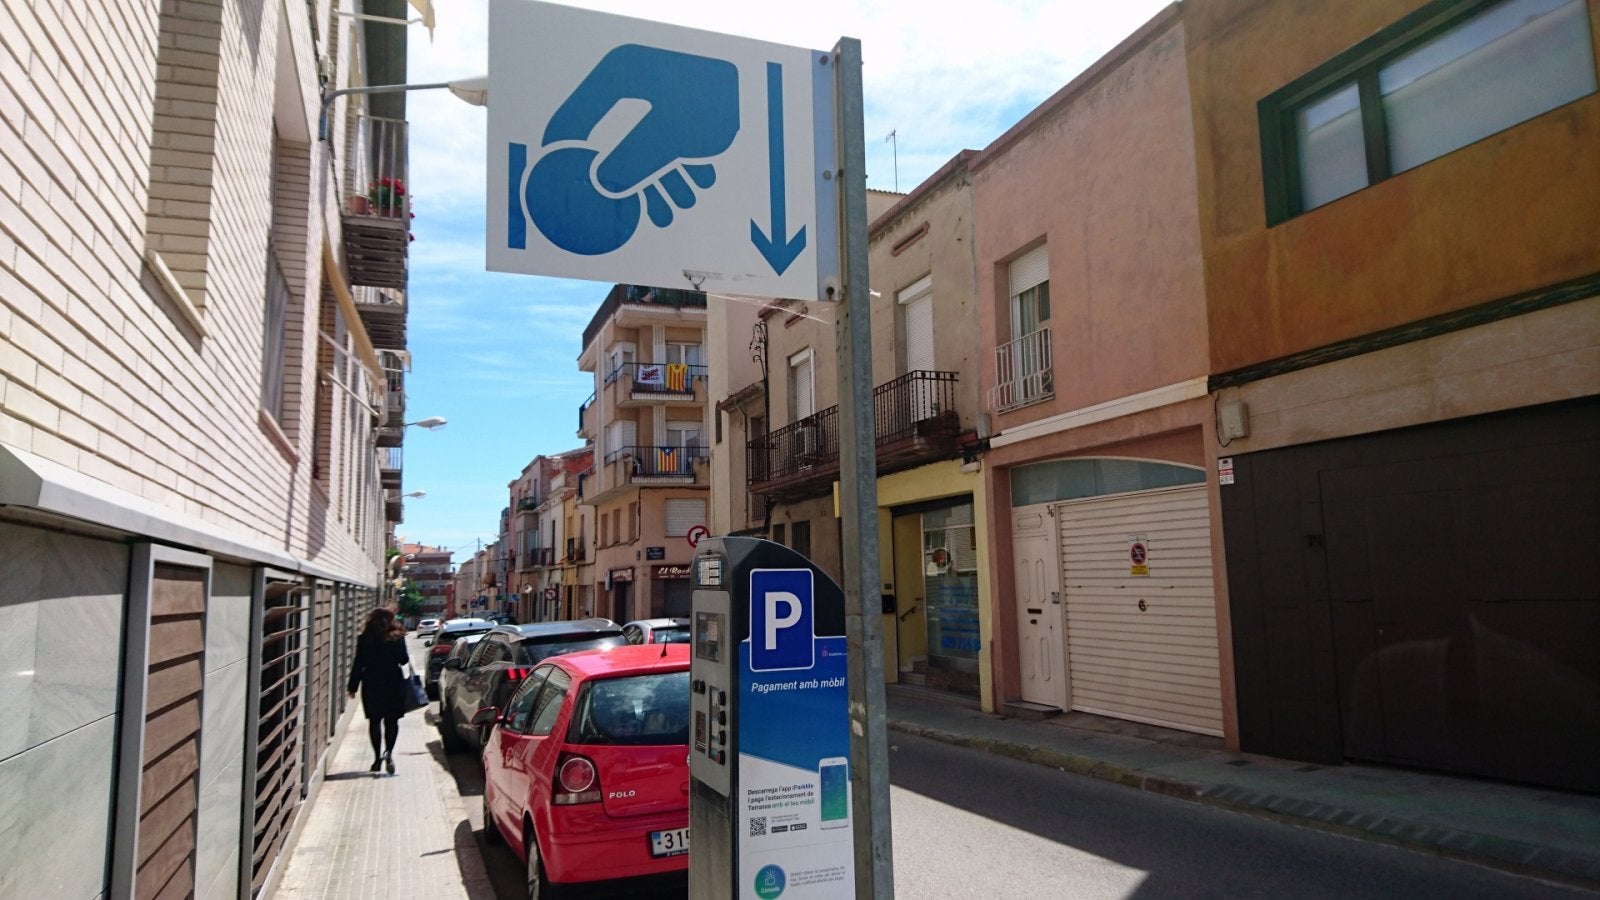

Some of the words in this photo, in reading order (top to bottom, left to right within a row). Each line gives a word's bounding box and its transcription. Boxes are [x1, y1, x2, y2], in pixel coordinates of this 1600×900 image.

[765, 592, 802, 650] P
[751, 680, 797, 693] Pagament
[799, 677, 818, 689] amb
[821, 677, 845, 688] mòbil
[609, 790, 635, 799] POLO
[765, 792, 806, 801] l'estacionament
